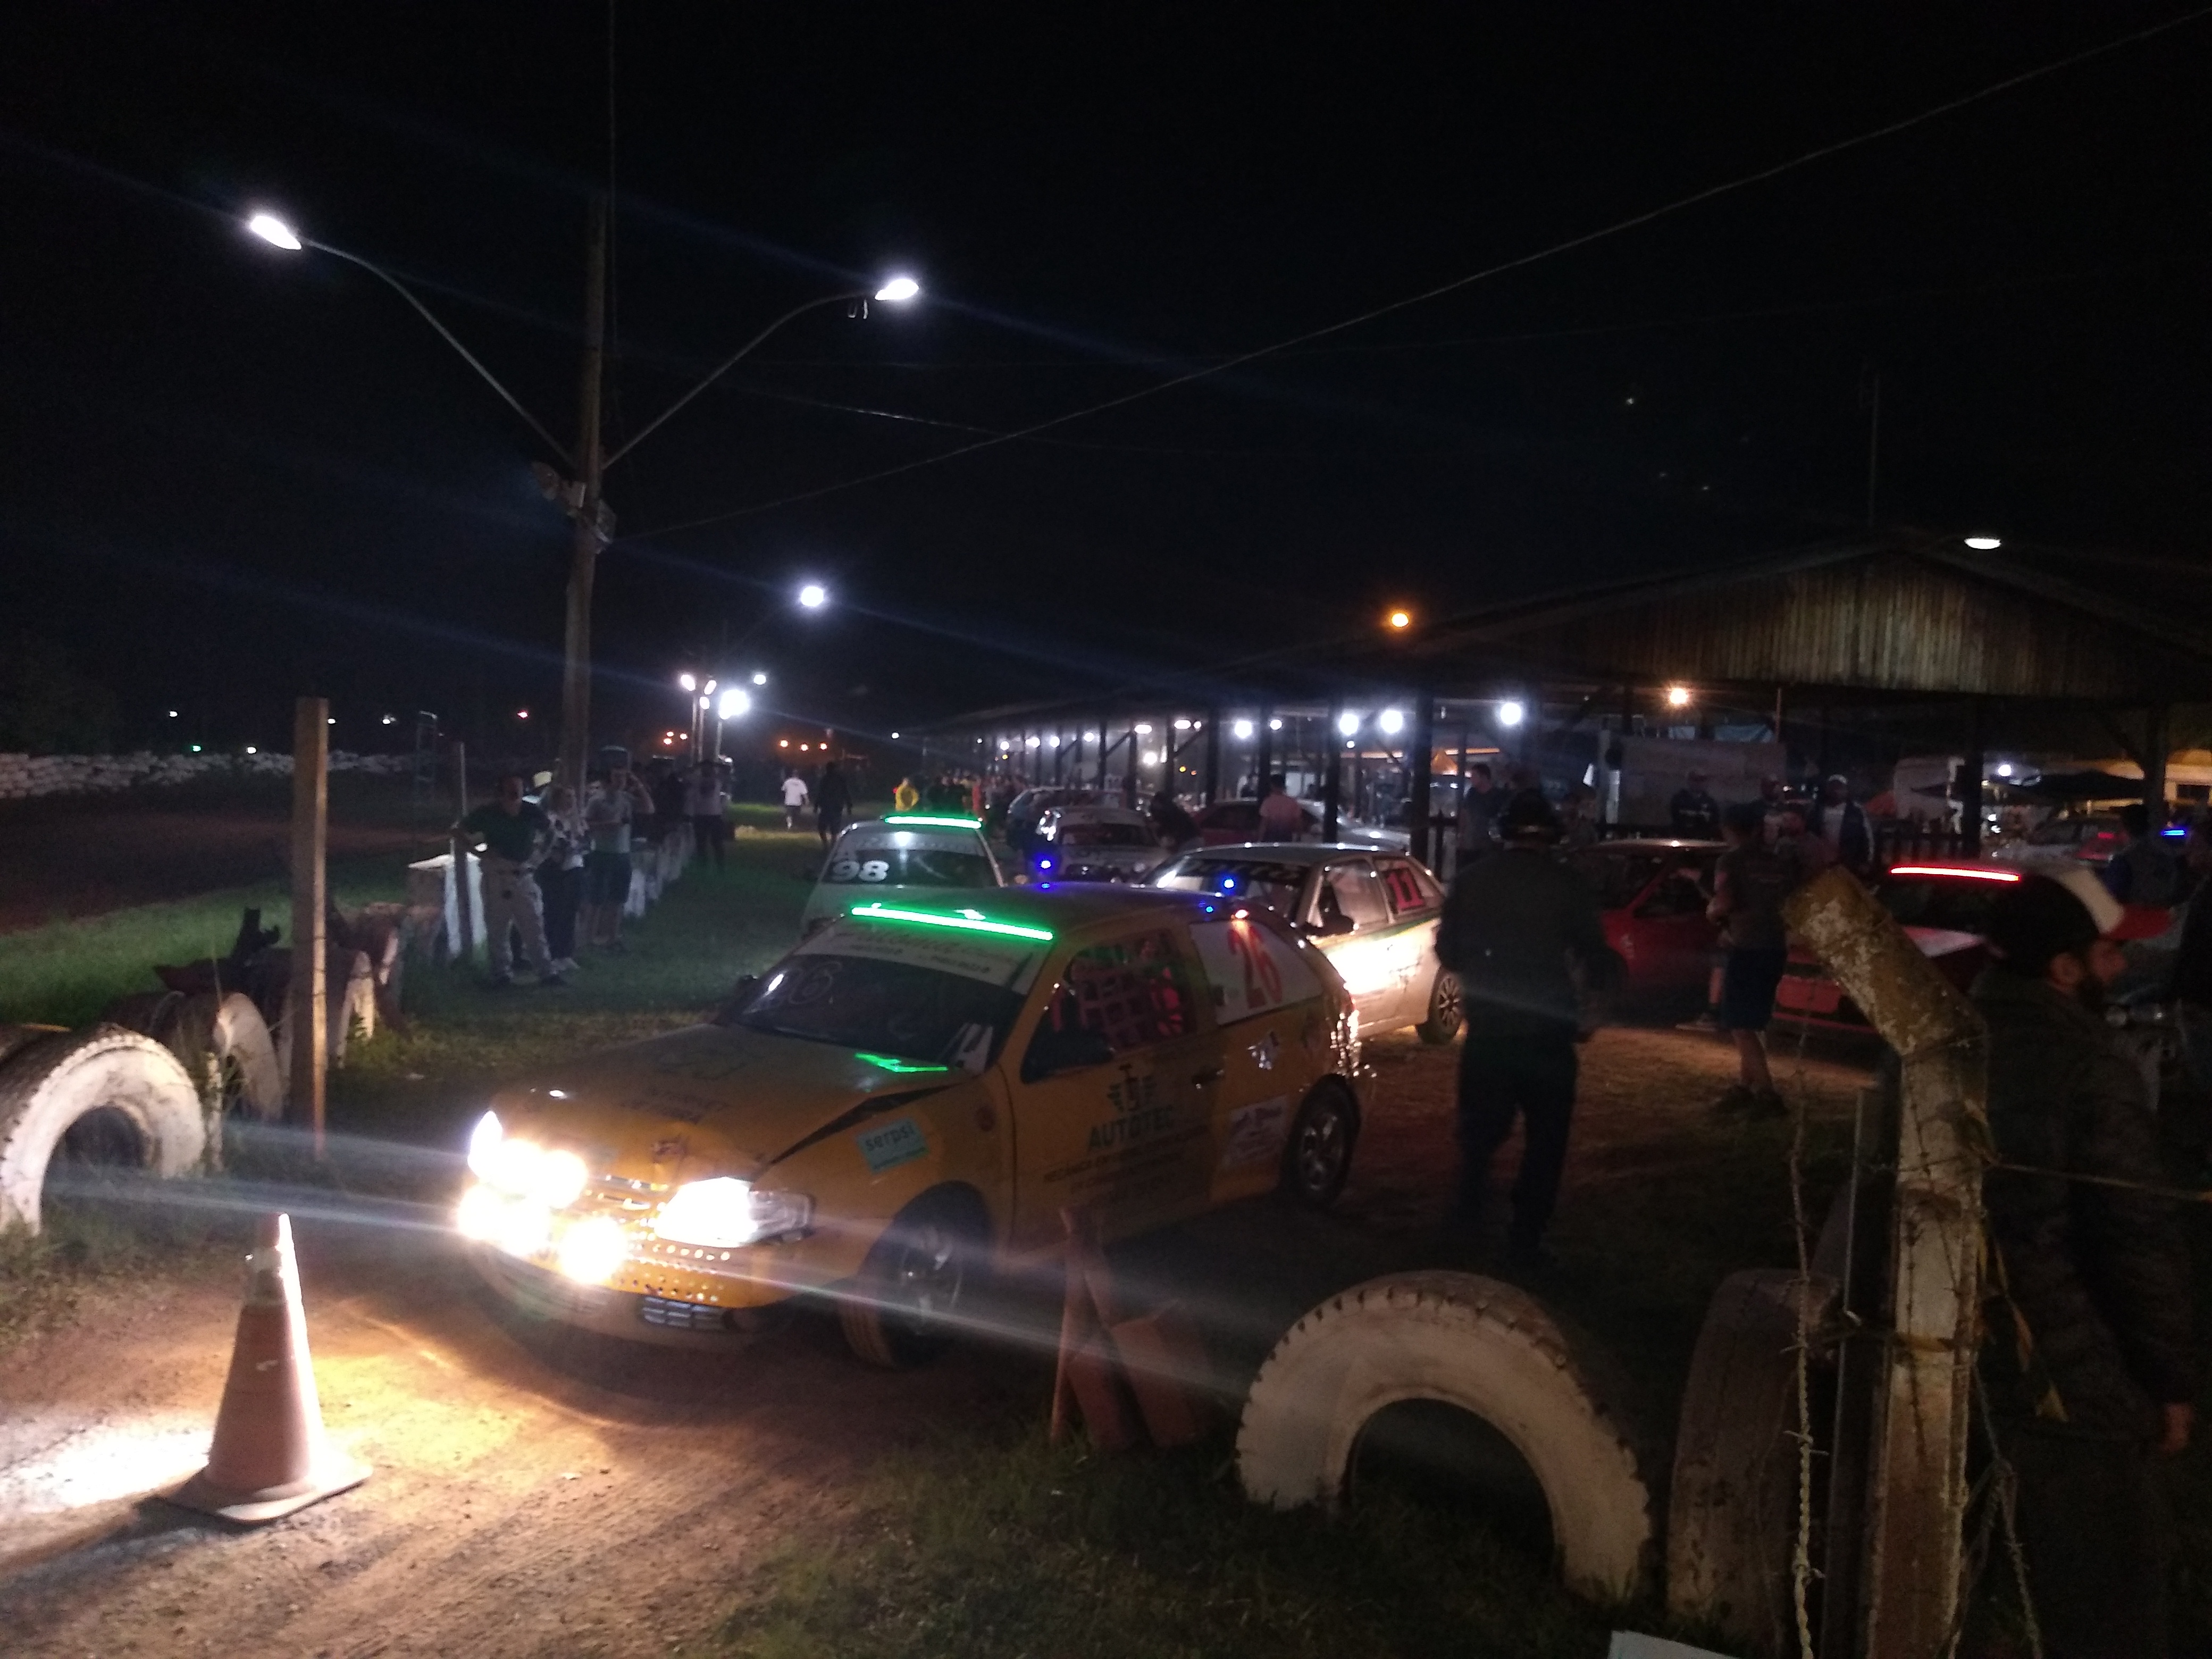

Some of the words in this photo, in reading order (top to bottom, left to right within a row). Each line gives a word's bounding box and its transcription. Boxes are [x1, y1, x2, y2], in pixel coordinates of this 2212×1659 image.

[832, 860, 890, 882] 98
[1228, 924, 1283, 1009] 26
[865, 1120, 916, 1152] serpsi
[1088, 1106, 1175, 1150] AUTOTEC
